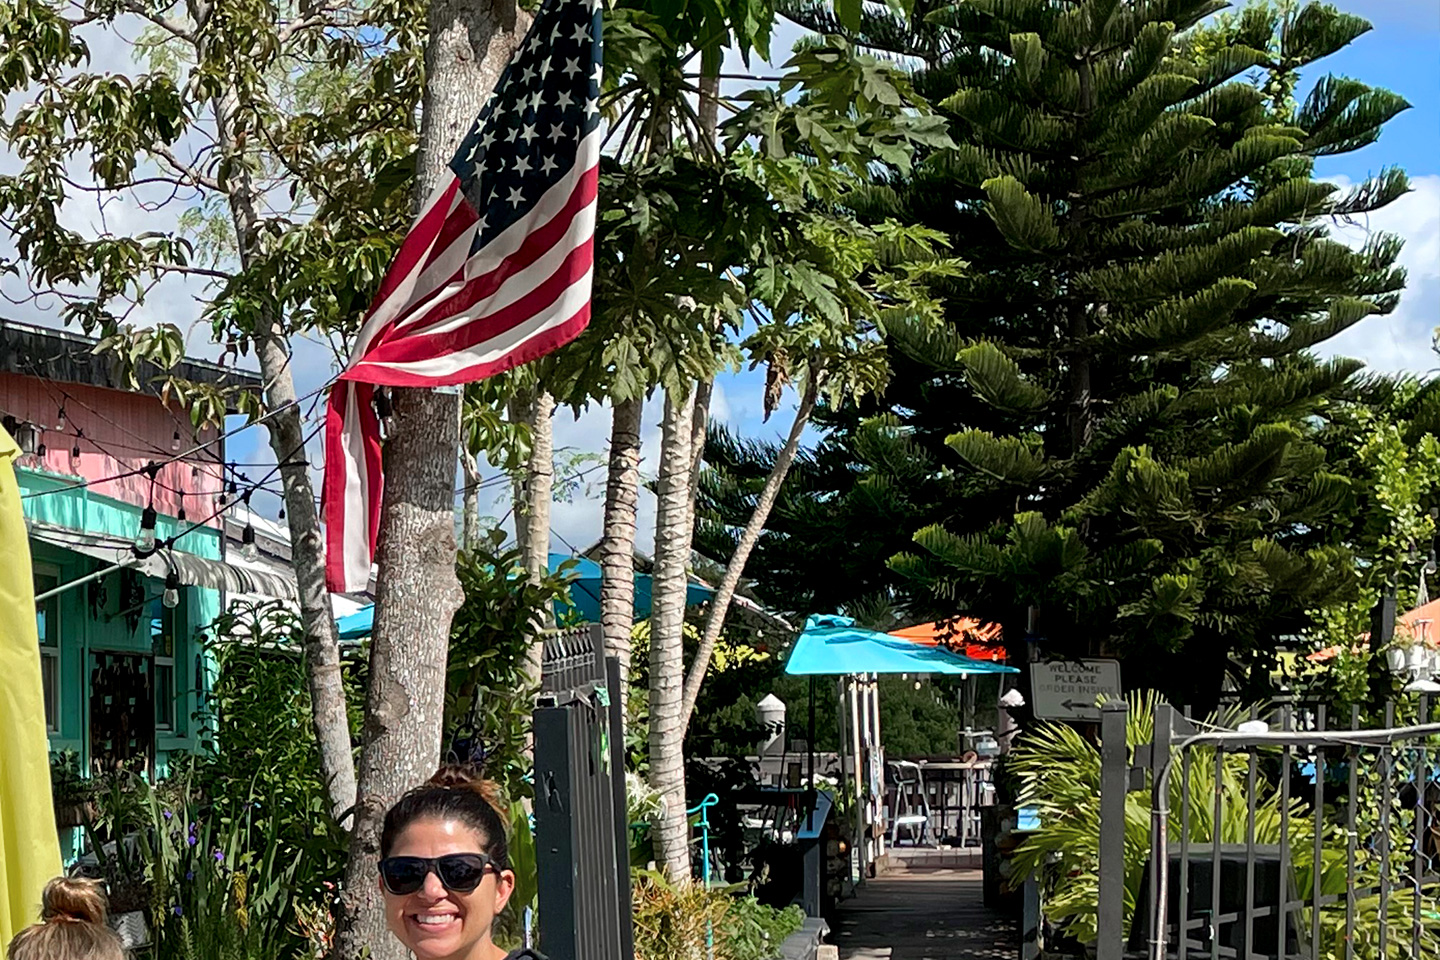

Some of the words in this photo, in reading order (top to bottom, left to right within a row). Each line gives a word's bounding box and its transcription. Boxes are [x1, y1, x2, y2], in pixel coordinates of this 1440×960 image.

[1049, 664, 1102, 674] WELCOME
[1055, 674, 1097, 684] PLEASE
[1040, 684, 1075, 693] ORDER
[1078, 685, 1114, 695] INSIDE
